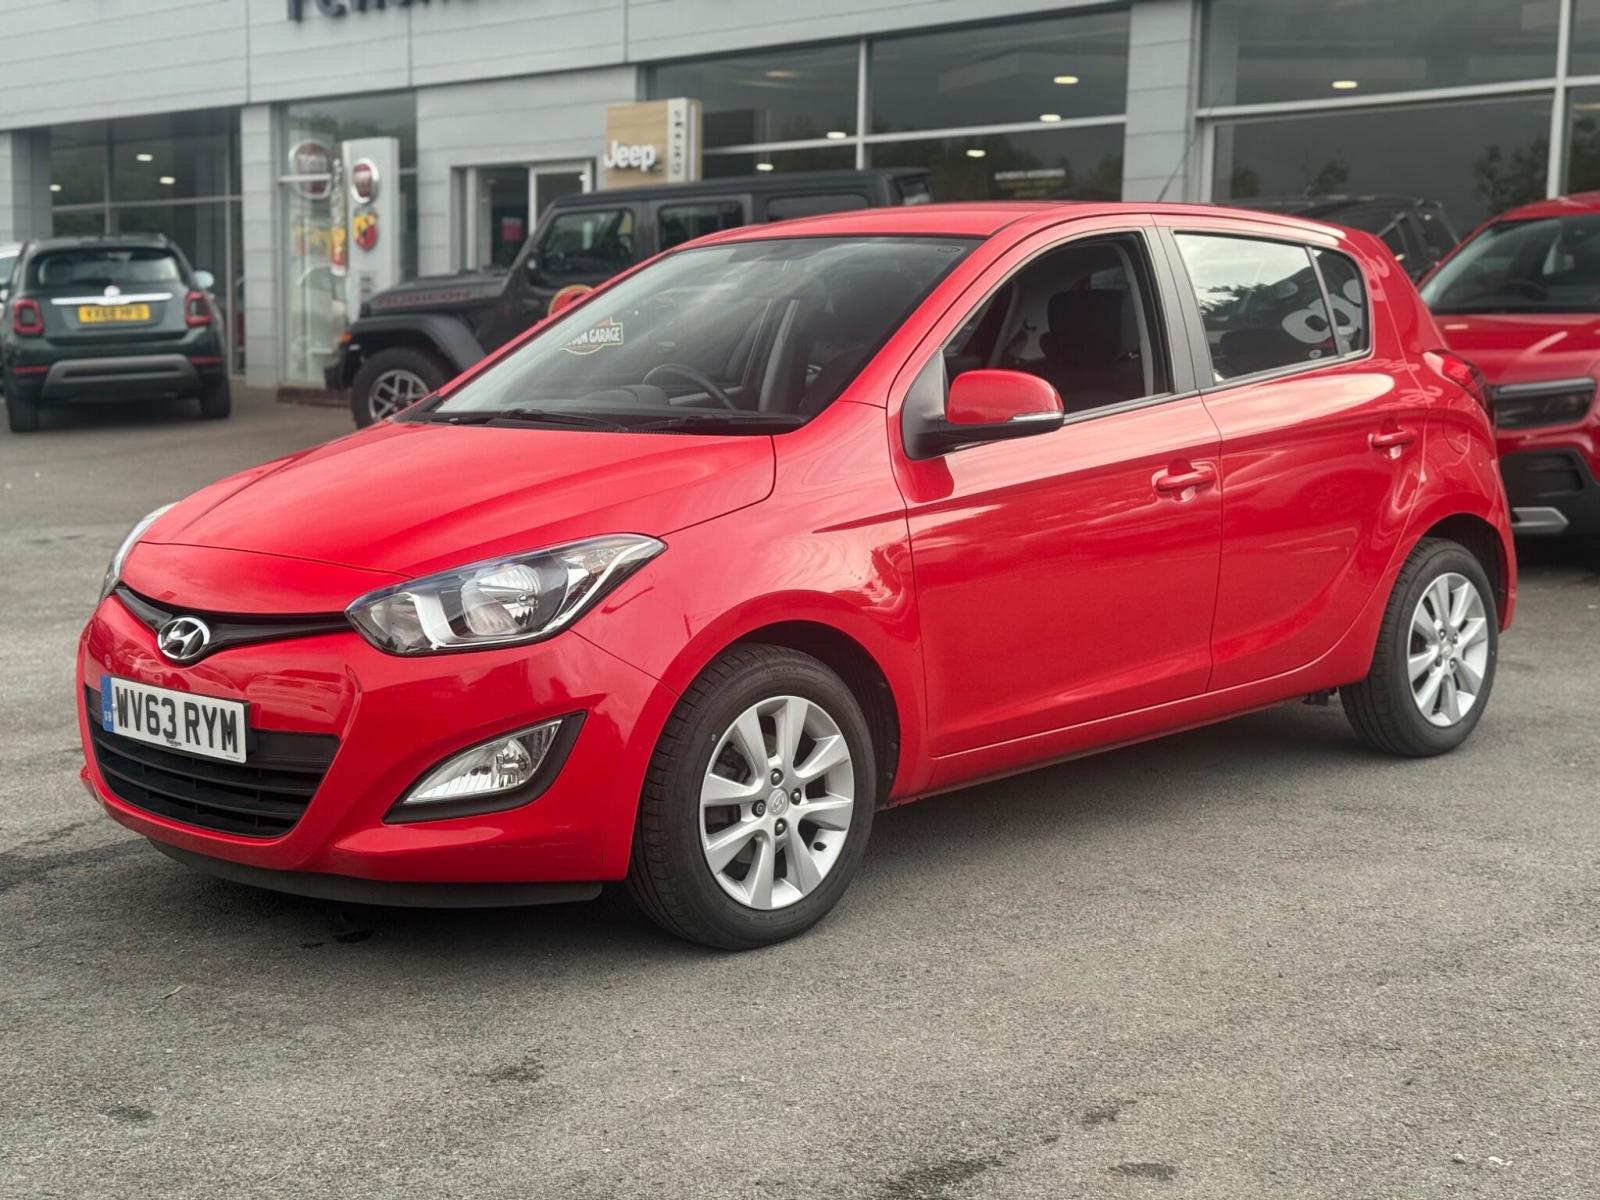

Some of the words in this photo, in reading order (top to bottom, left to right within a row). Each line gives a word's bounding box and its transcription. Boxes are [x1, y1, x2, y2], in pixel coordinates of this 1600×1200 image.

[603, 138, 656, 172] Jeep
[589, 326, 621, 344] GARAGE
[115, 686, 177, 740] WV63
[184, 701, 238, 753] RYM
